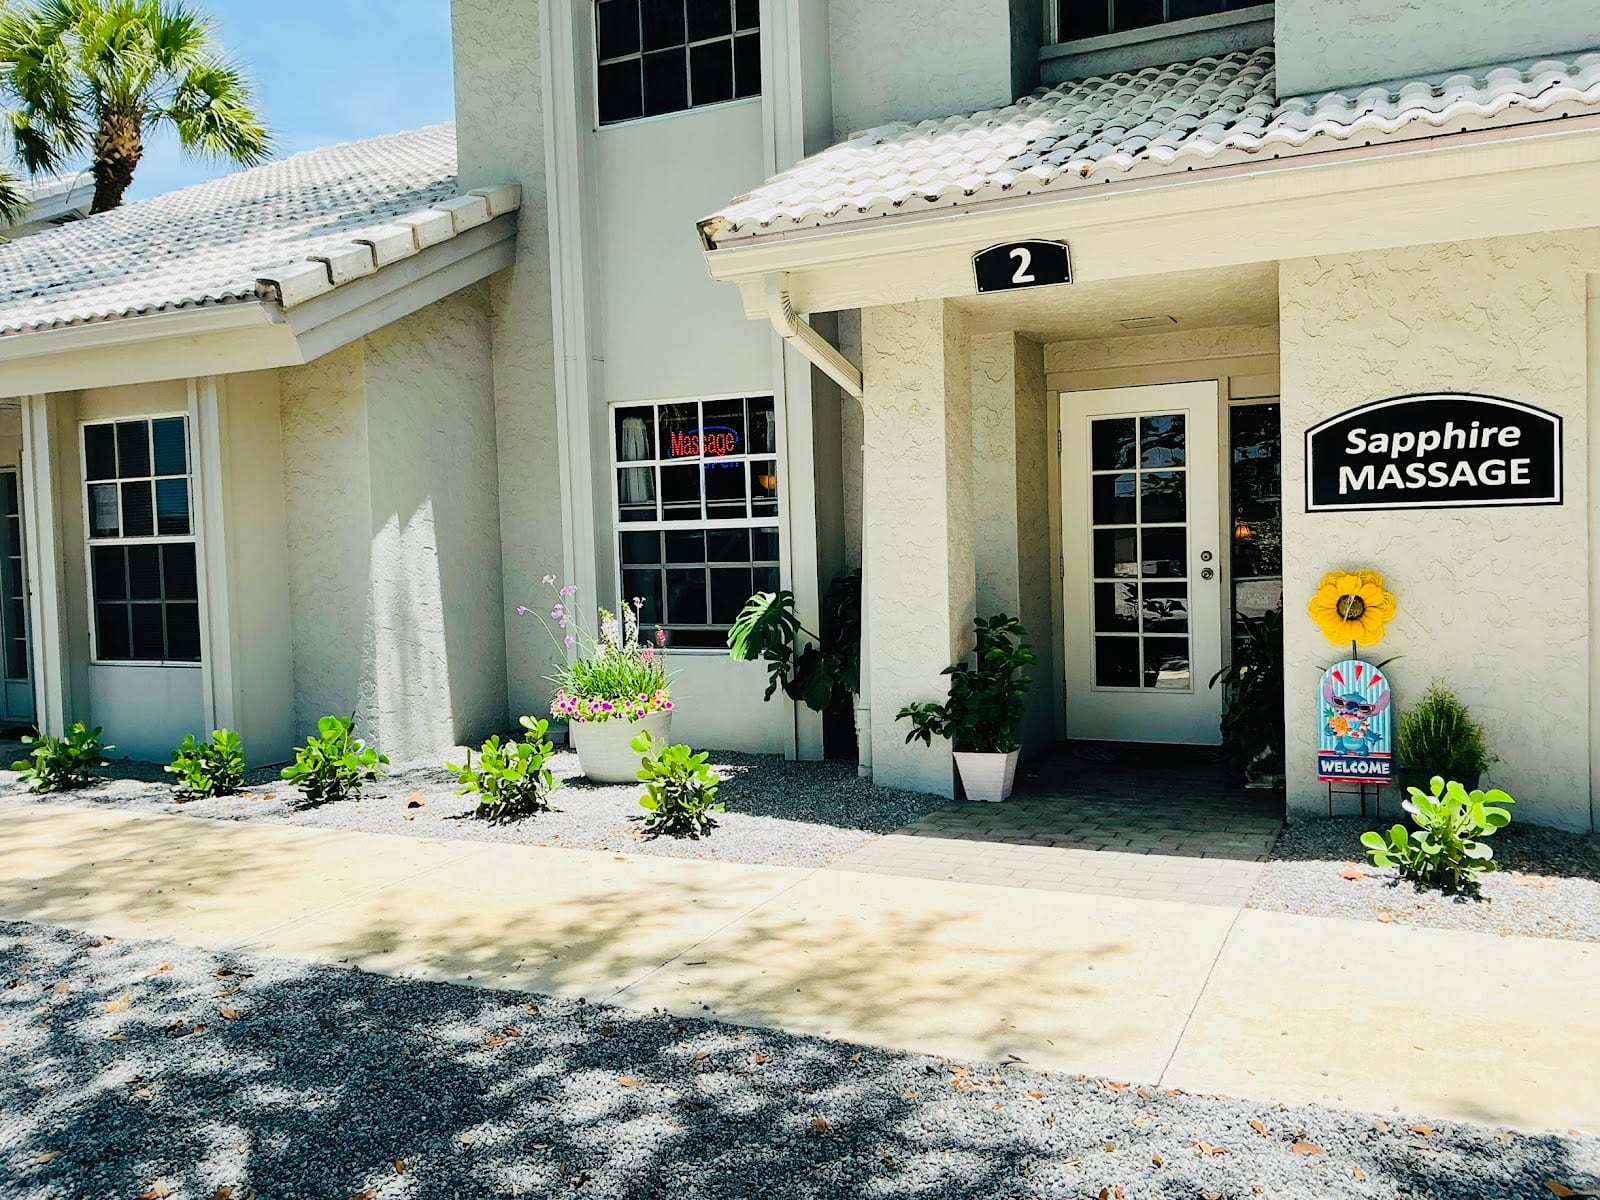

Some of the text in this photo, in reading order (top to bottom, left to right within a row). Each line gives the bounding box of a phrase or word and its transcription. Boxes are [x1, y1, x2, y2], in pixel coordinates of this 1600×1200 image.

[1009, 247, 1036, 284] 2
[1345, 421, 1522, 459] Sapphire
[1338, 458, 1531, 495] MASSAGE
[1320, 760, 1390, 774] WELCOME
